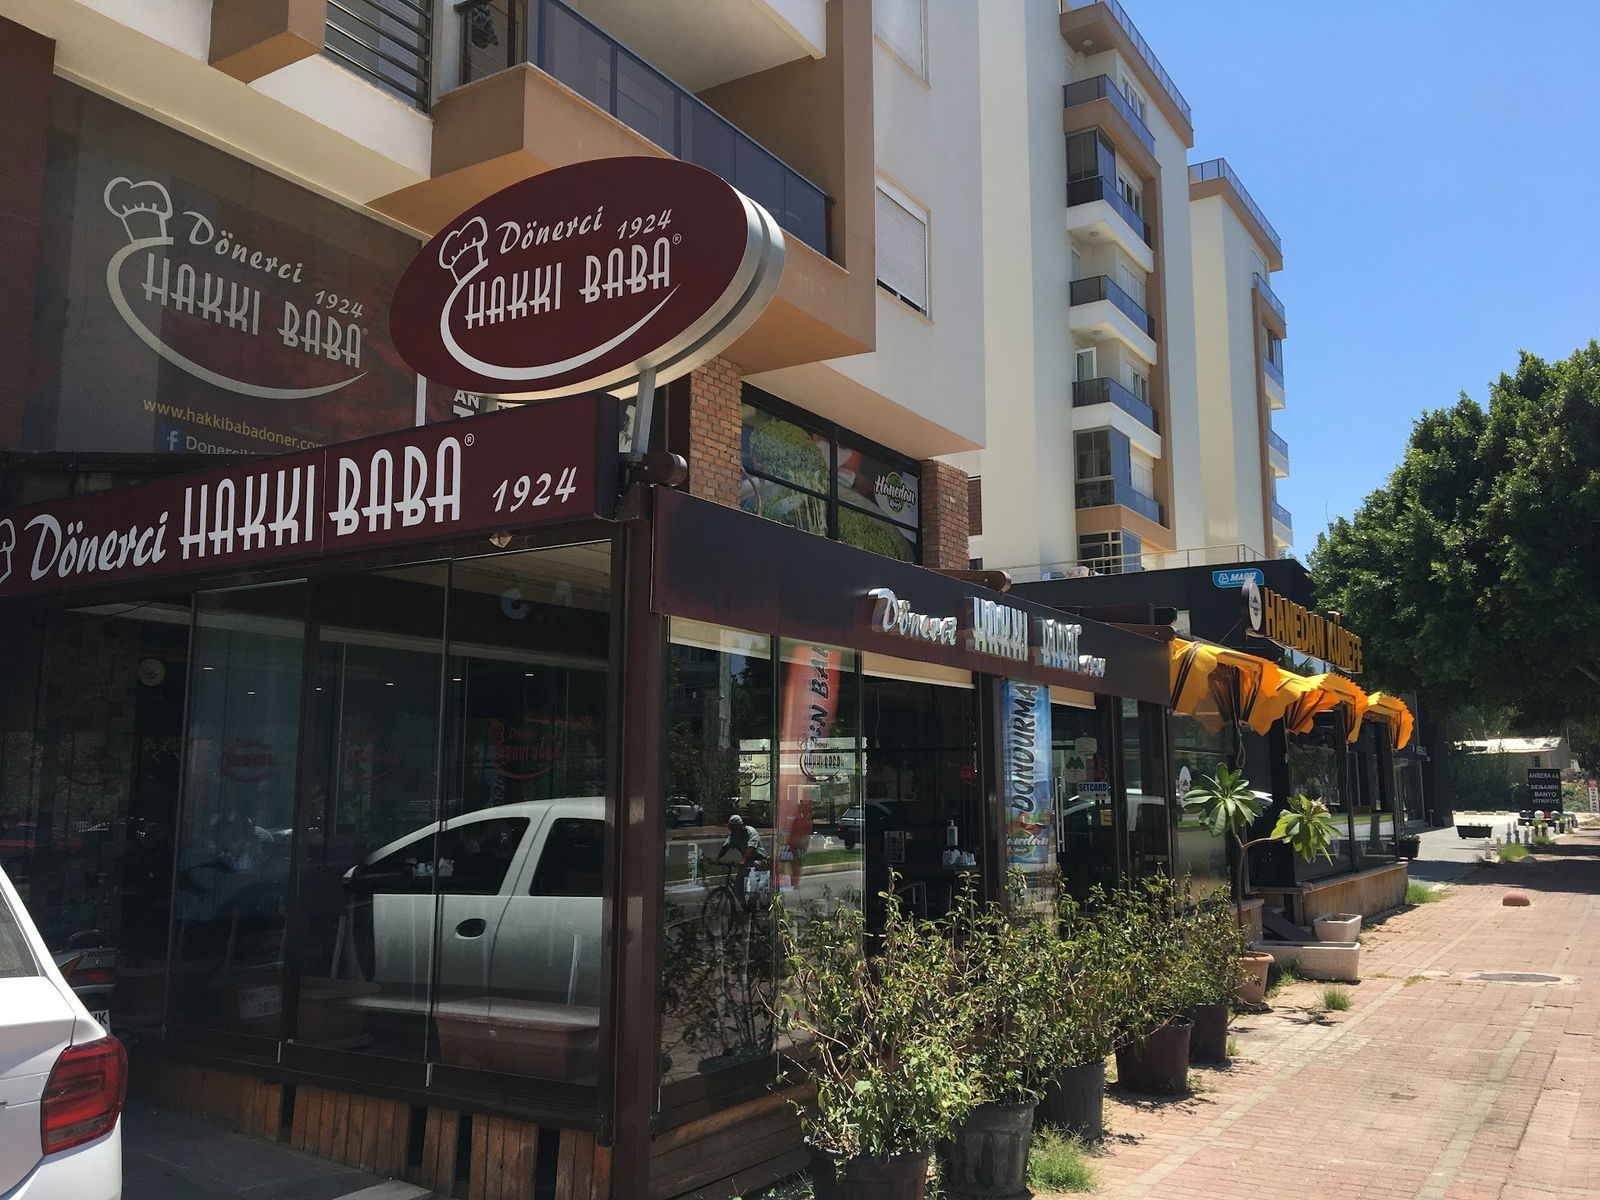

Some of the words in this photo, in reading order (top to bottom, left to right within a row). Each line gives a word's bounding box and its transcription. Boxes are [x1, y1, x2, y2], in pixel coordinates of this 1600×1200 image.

[183, 210, 303, 284] Dönerci
[314, 290, 364, 319] 1924
[495, 206, 604, 255] Dönerci
[617, 208, 672, 240] 1924
[142, 252, 260, 336] HAKKI
[464, 262, 562, 330] HAKKI
[23, 511, 169, 581] Dönerci
[178, 464, 315, 560] HAKKI
[492, 466, 577, 512] 1924
[1264, 587, 1326, 659] HANEDAN
[1009, 683, 1039, 813] DONDURMA
[1079, 783, 1107, 792] SETCARD
